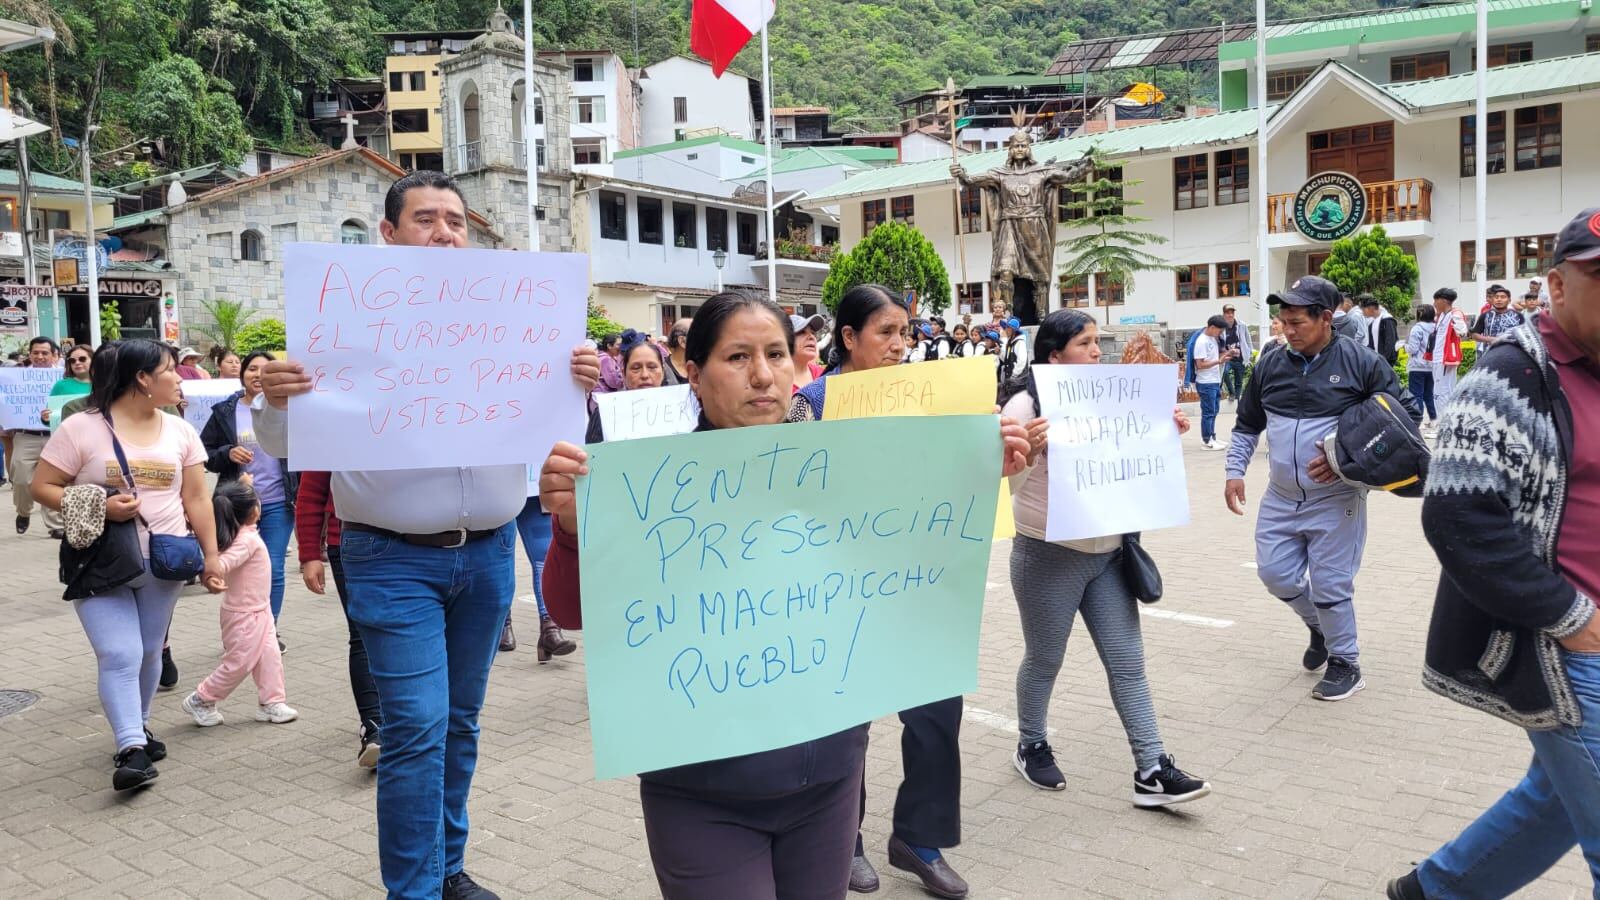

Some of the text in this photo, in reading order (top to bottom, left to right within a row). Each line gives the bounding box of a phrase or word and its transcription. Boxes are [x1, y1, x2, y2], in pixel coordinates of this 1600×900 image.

[1300, 175, 1361, 200] MACHUPICCHU
[1296, 205, 1315, 236] PUEBLOS
[1335, 206, 1361, 237] ABRAZAN
[11, 287, 51, 297] BOTICA
[98, 280, 144, 294] ATINO
[318, 262, 558, 314] AGENCIAS
[307, 317, 561, 354] EL TURISMO NO
[312, 355, 551, 393] ES SOLO PARA
[1057, 375, 1142, 406] MINISTRA
[368, 396, 523, 435] USTEDES
[836, 379, 937, 419] MINISTRA
[1075, 454, 1166, 492] RENUNCIA
[645, 494, 984, 584] PRESENCIAL
[625, 565, 946, 648] EN MACHUPICCHU
